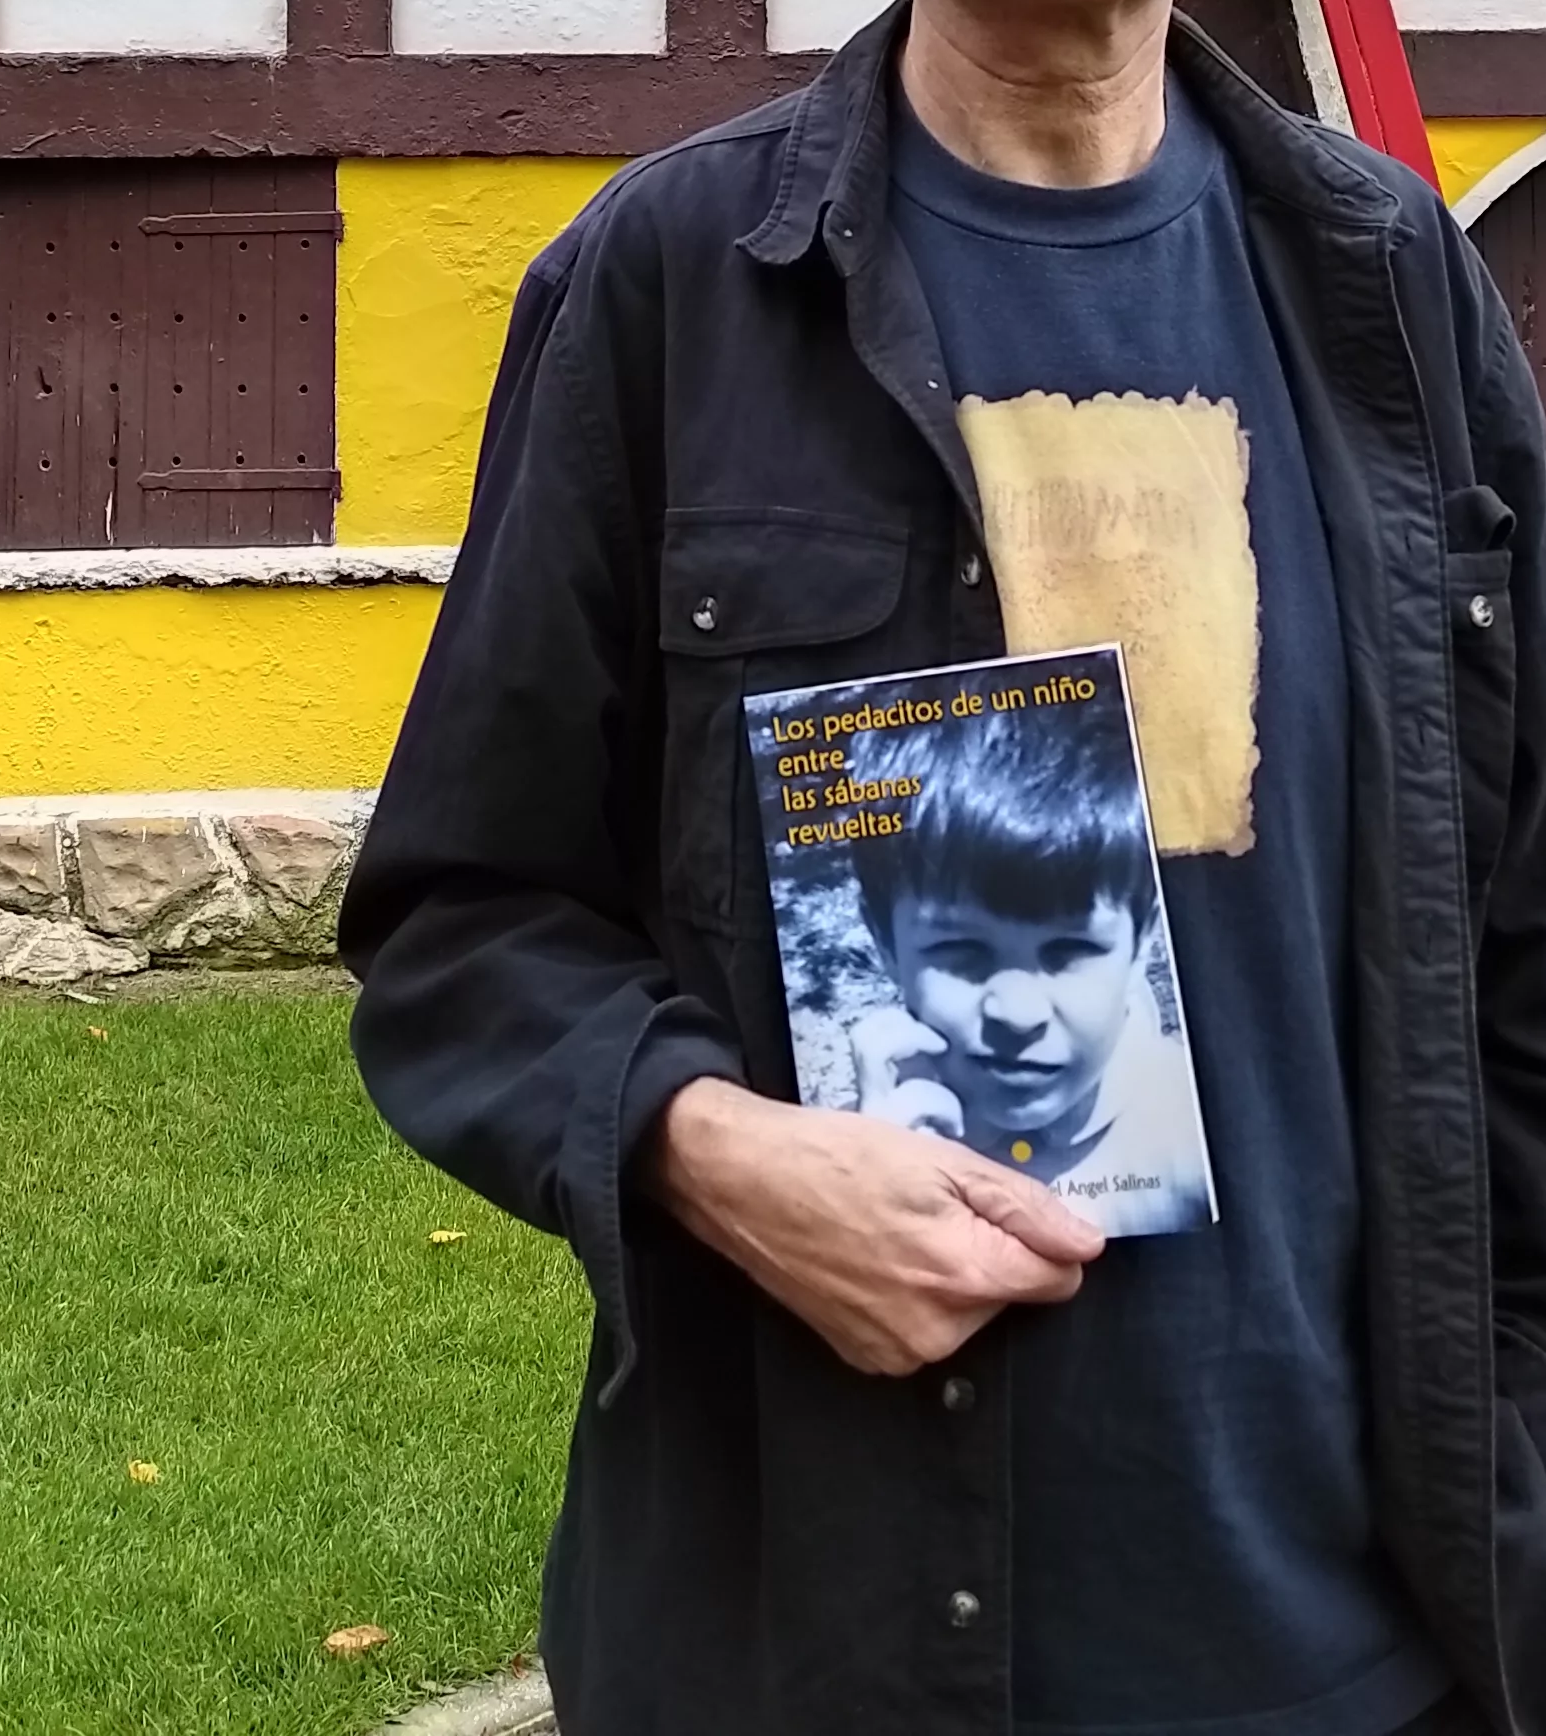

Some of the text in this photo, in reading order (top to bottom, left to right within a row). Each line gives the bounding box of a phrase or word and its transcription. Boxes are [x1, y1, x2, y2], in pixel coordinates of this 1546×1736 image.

[772, 676, 1096, 743] Los pedacitos de un niño
[777, 749, 845, 777] entre
[782, 774, 921, 812] las sábanas
[787, 811, 903, 846] revueltas
[1068, 1175, 1109, 1199] Angel
[1112, 1173, 1161, 1192] Salinas
